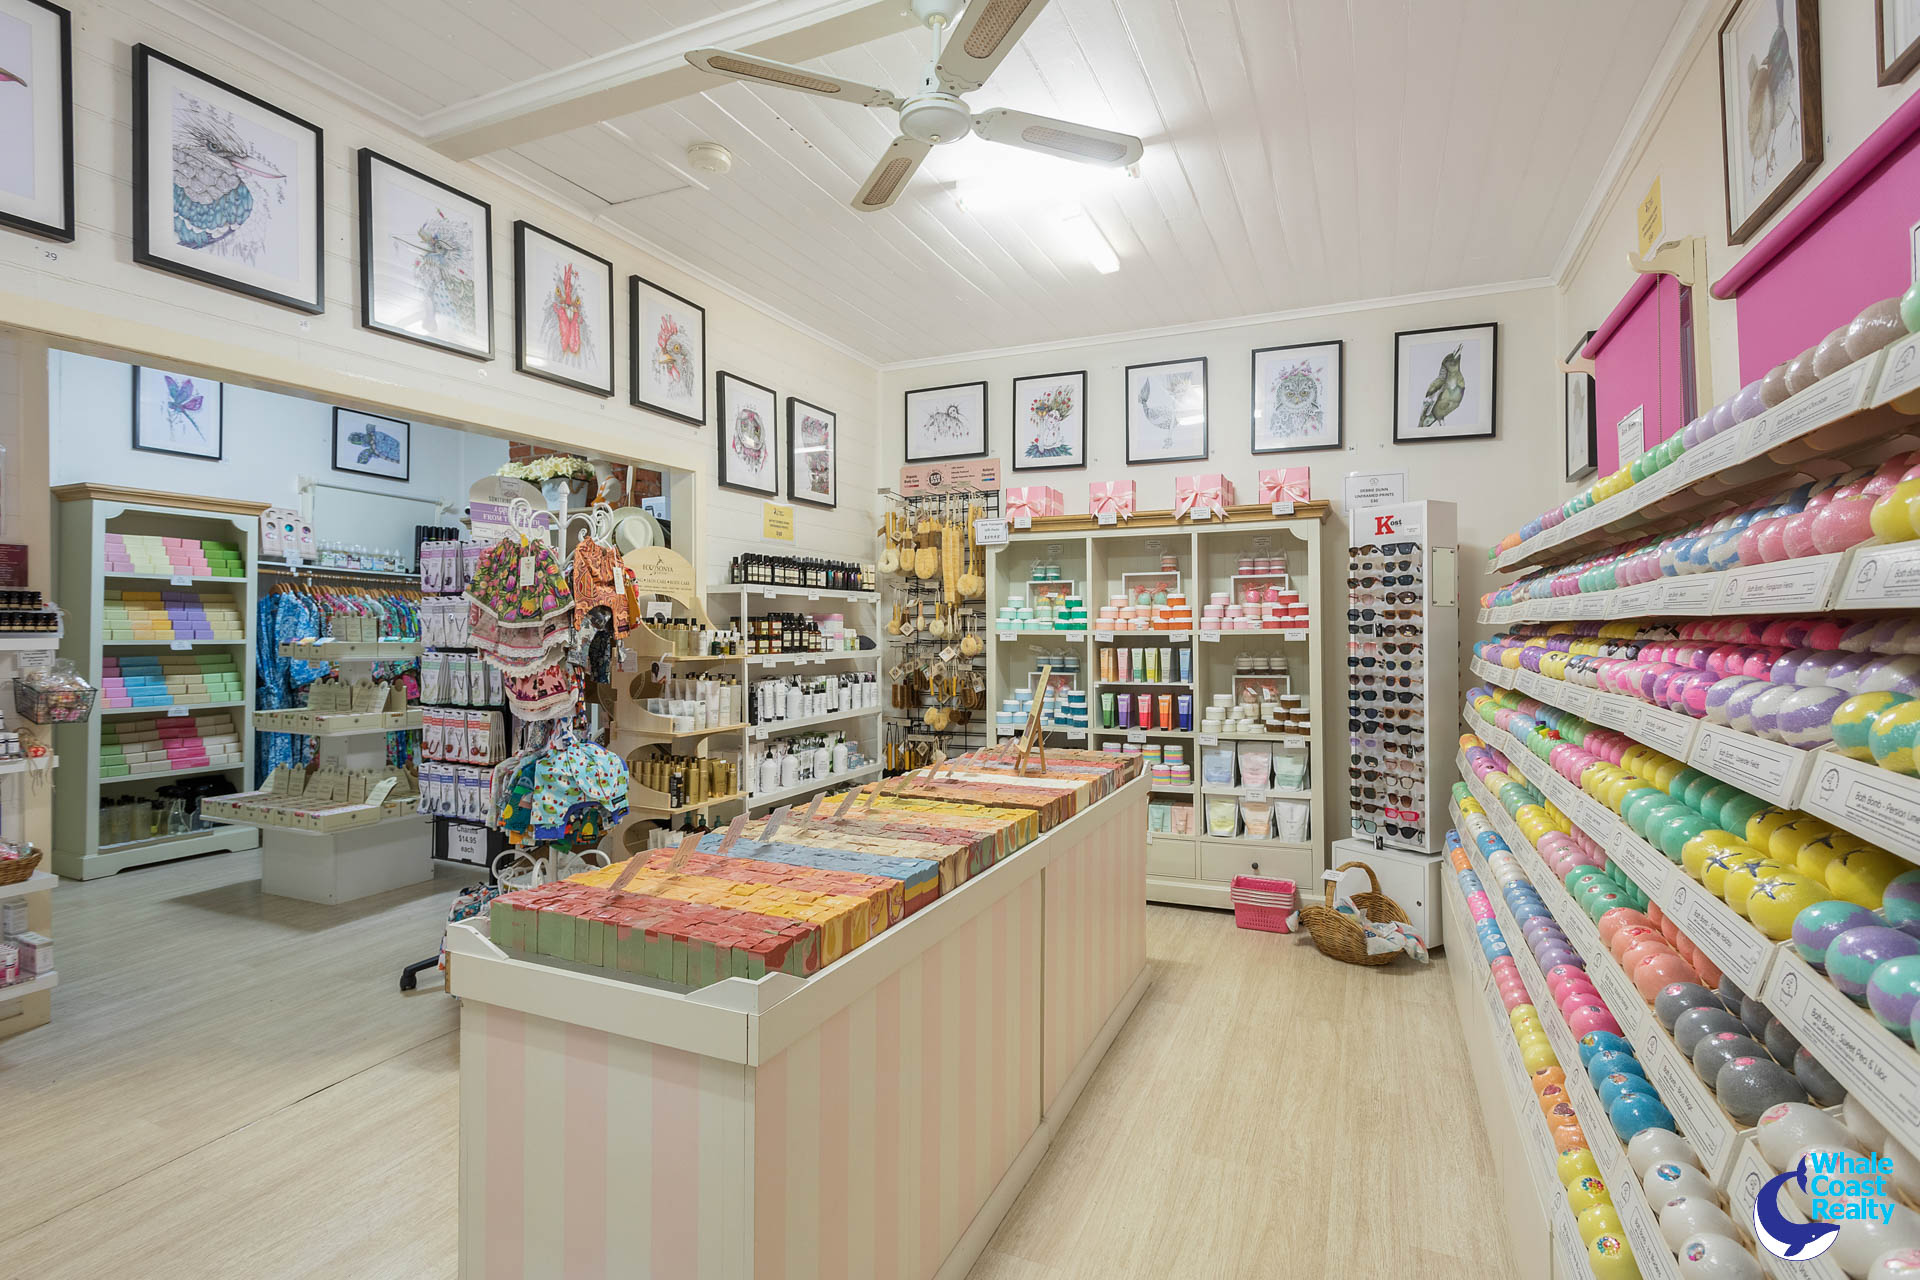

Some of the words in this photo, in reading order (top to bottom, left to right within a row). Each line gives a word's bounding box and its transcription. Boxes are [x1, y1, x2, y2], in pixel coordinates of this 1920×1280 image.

[1855, 791, 1866, 803] Bath
[1866, 795, 1881, 808] Bomb
[1886, 802, 1906, 818] Persian
[460, 846, 475, 854] each
[1811, 1007, 1822, 1024] Bath
[1823, 1016, 1836, 1036] Bomb
[1839, 1033, 1856, 1055] Sweet
[1856, 1049, 1868, 1066] Pea
[1874, 1064, 1888, 1083] Lilac
